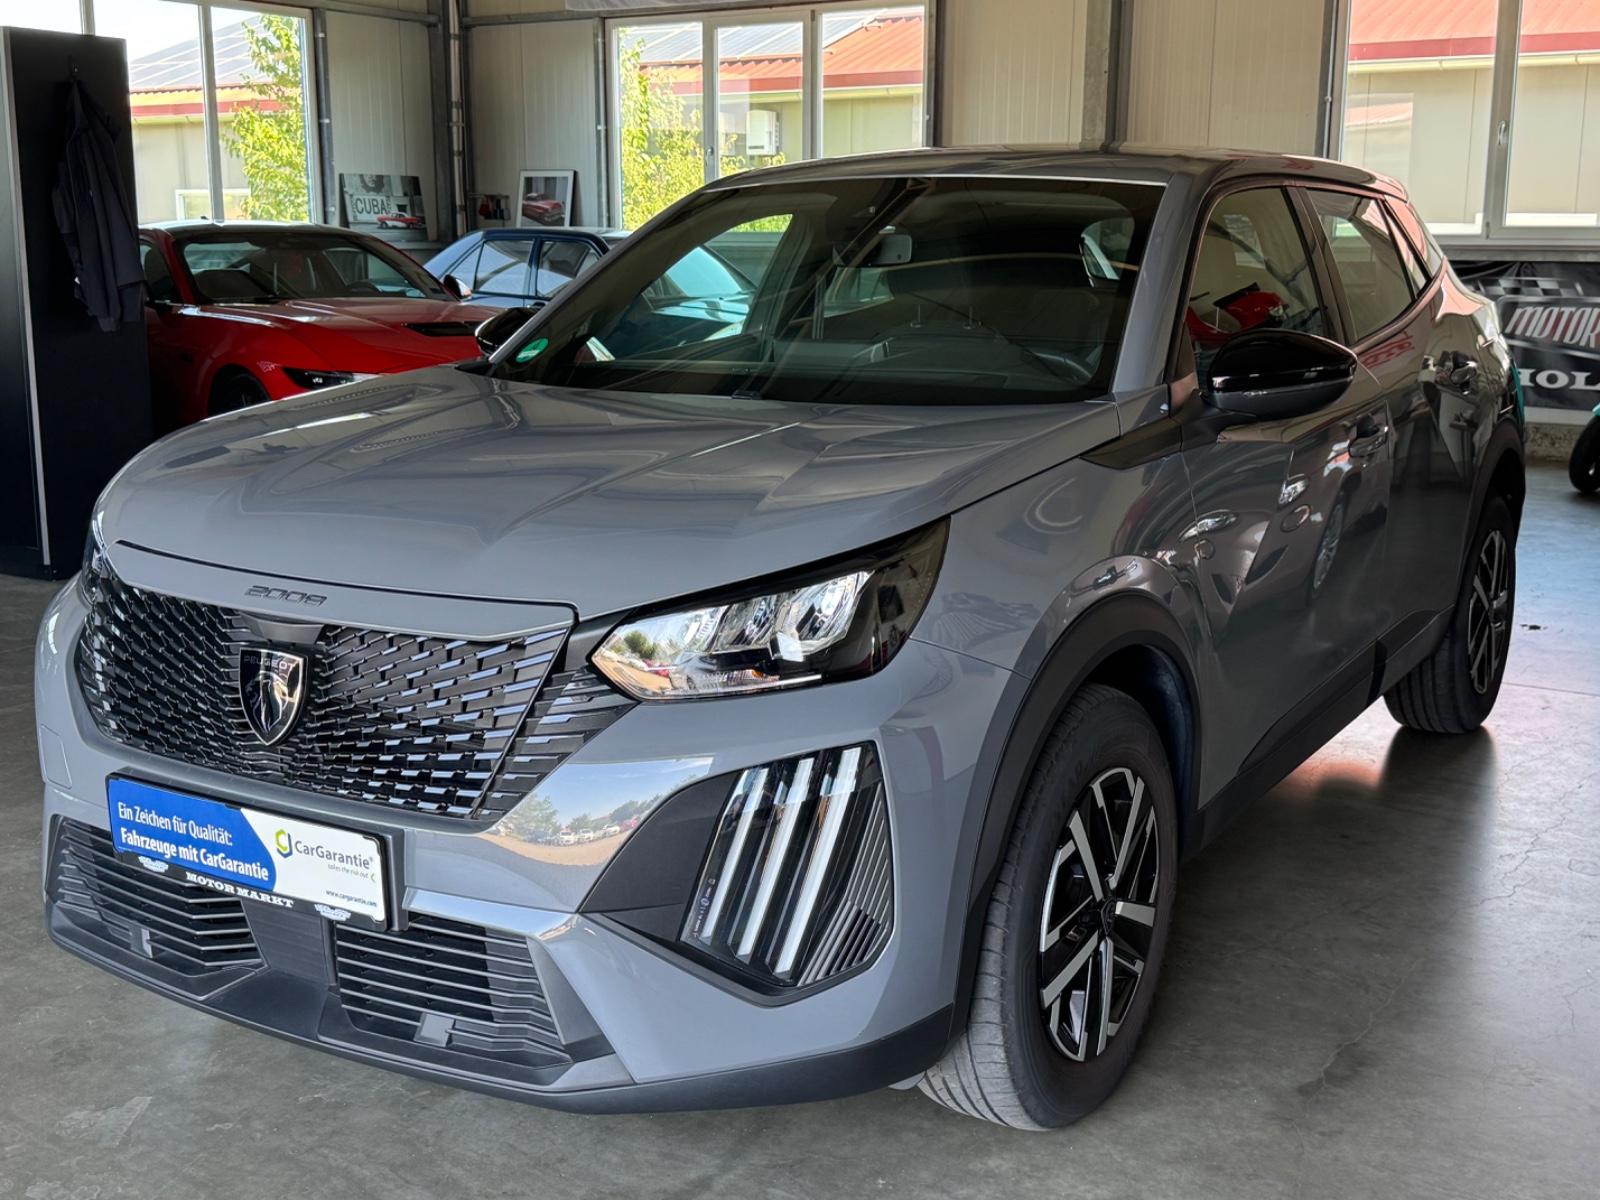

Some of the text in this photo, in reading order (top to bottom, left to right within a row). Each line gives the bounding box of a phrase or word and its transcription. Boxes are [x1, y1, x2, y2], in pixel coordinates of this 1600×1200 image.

[355, 197, 387, 215] CUBA
[1504, 306, 1600, 348] MOTOR
[244, 585, 328, 606] 2008
[117, 801, 233, 846] Ein Zeichen für Qualität:
[121, 827, 177, 859] Fahrzeuge
[178, 844, 199, 863] mit
[200, 848, 269, 881] CarGarantie
[185, 871, 294, 908] MOTOR MARKT
